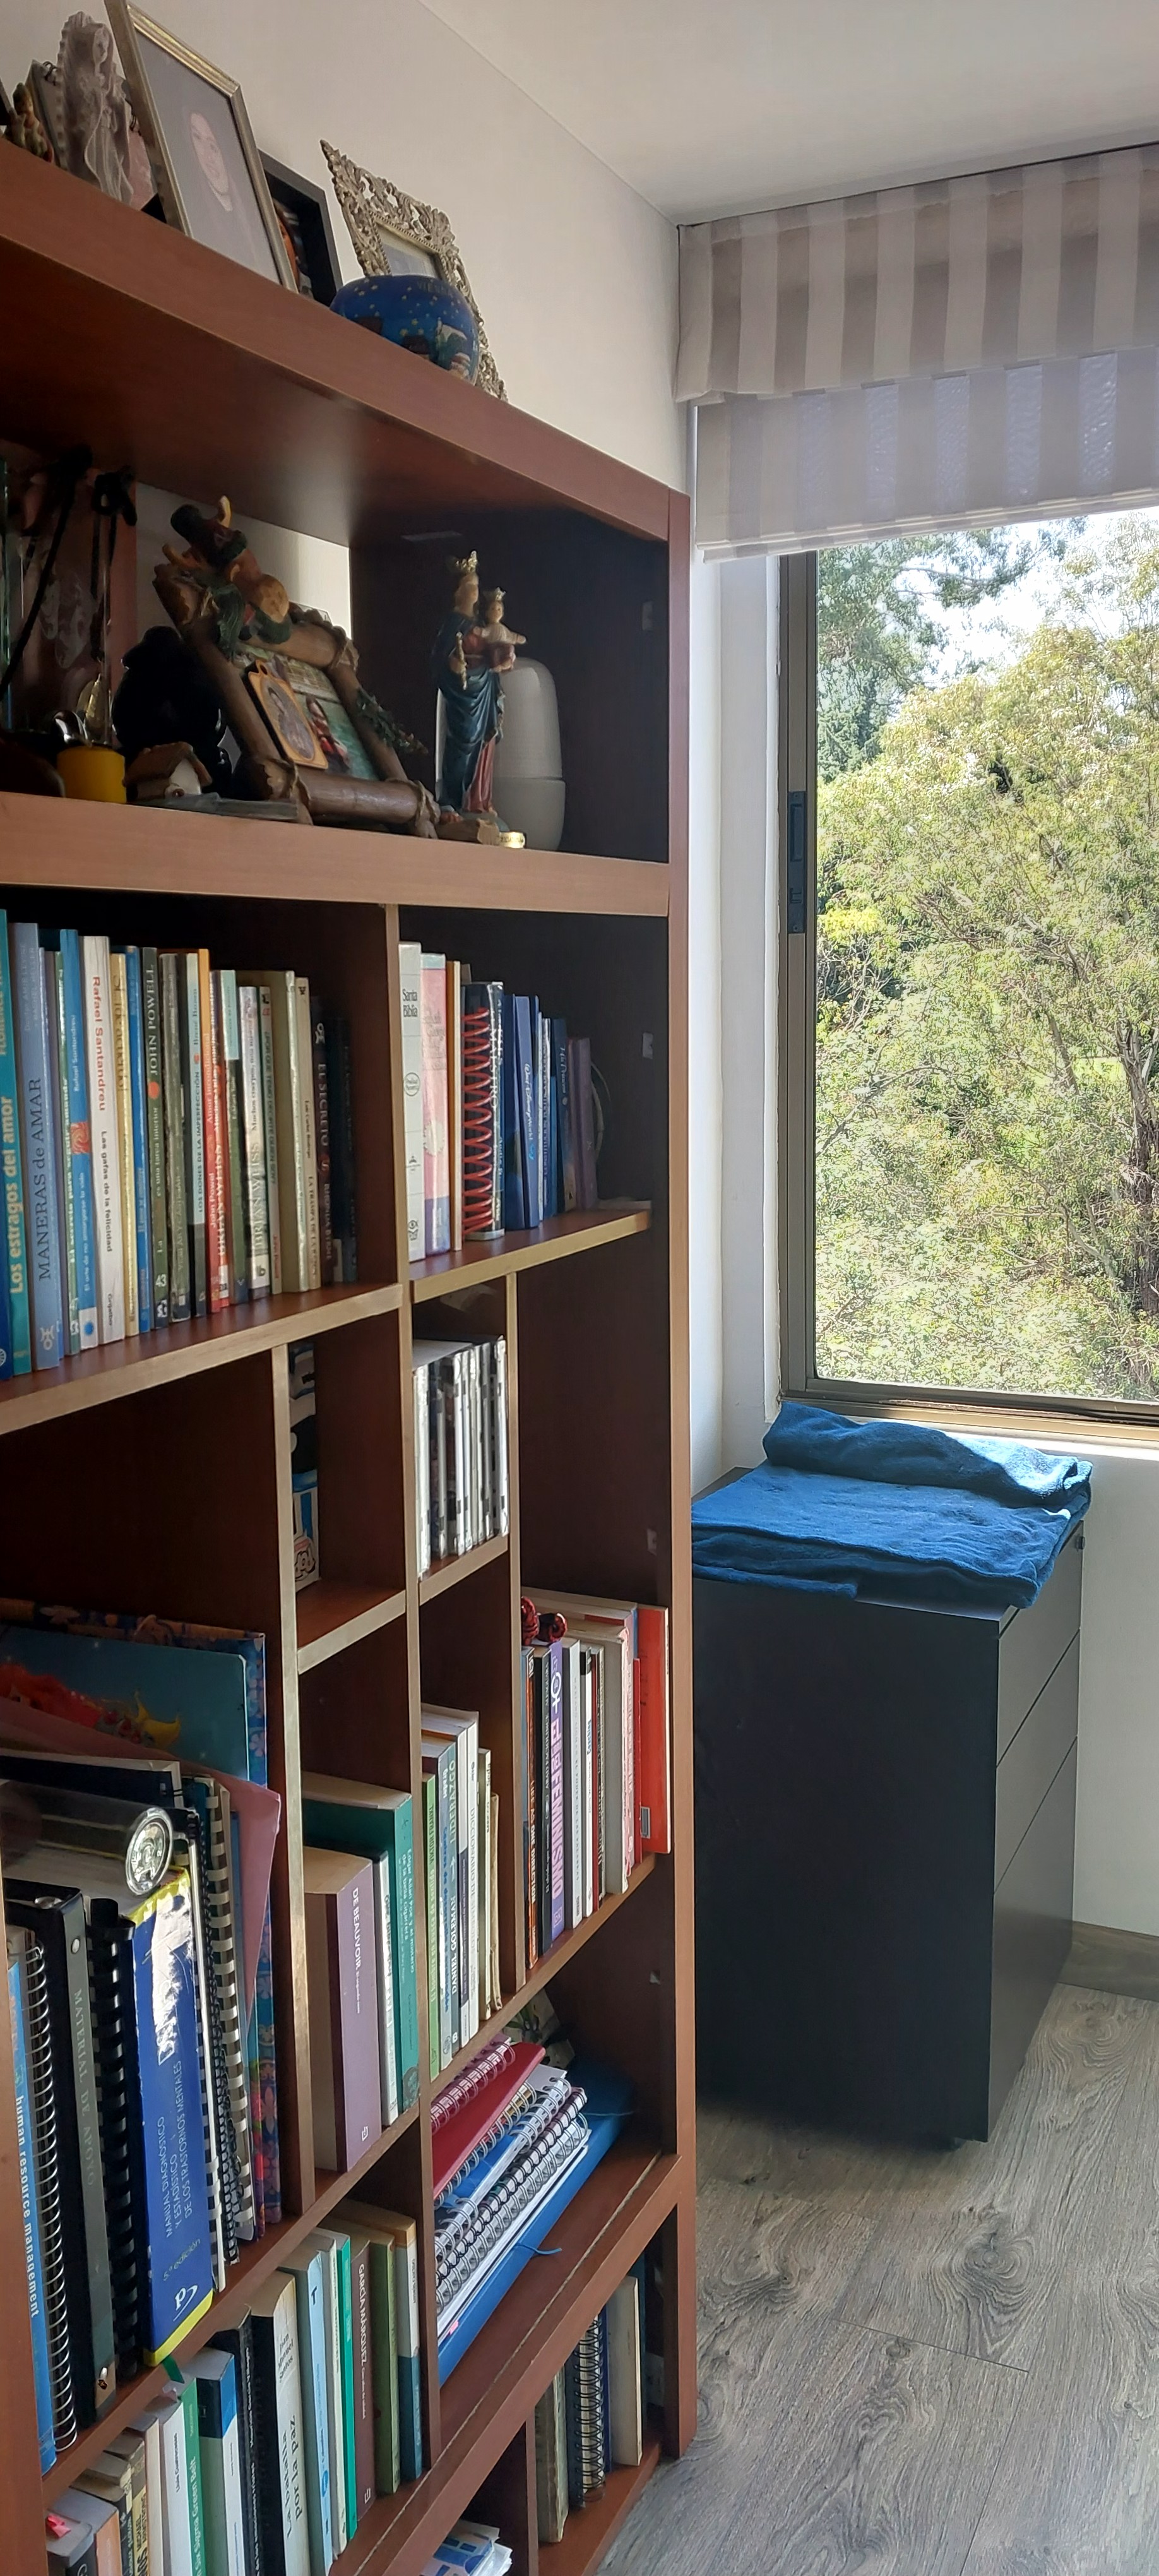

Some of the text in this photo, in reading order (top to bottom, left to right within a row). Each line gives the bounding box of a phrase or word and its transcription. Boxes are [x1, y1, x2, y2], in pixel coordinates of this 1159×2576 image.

[402, 988, 418, 1002] Santa
[403, 1005, 419, 1018] Biblia
[146, 964, 158, 1075] JOHN POWELL
[92, 976, 107, 1112] Rafael Santandreu
[203, 1033, 211, 1096] incondicional
[318, 1063, 329, 1147] EL SECRETO
[196, 1138, 202, 1150] LA
[197, 1151, 202, 1162] DE
[28, 1077, 51, 1281] MANERAS de AMAR
[101, 1152, 110, 1181] gafas
[1, 1097, 23, 1293] Los estragos del amor
[104, 1183, 110, 1195] de
[105, 1197, 111, 1207] la
[155, 1186, 162, 1197] es
[251, 1142, 264, 1246] BRIAN WEISS
[105, 1209, 113, 1252] felicidad
[157, 1240, 163, 1253] La
[156, 1273, 167, 1287] 43
[551, 1770, 564, 1900] FEMINISMO
[401, 1854, 408, 1867] de
[352, 1887, 362, 1970] DE BEAUVOIR
[73, 1988, 96, 2186] MATERIAL DE APOYO
[172, 2060, 193, 2217] DE LOS TRASTORNOS MENTALES
[157, 2116, 173, 2238] MANUAL DIAGNÓSTICO
[170, 2154, 182, 2218] ESTADÍSTICO
[15, 2095, 40, 2318] human resource management
[173, 2238, 201, 2269] edición
[358, 2263, 367, 2367] GARCÍA MÁRQUEZ
[278, 2333, 290, 2356] Juan
[278, 2338, 294, 2371] Manuel
[189, 2458, 198, 2483] Belt
[281, 2430, 292, 2538] La batalla
[288, 2414, 302, 2520] por la paz
[191, 2485, 199, 2515] Green
[192, 2517, 202, 2551] Sigma
